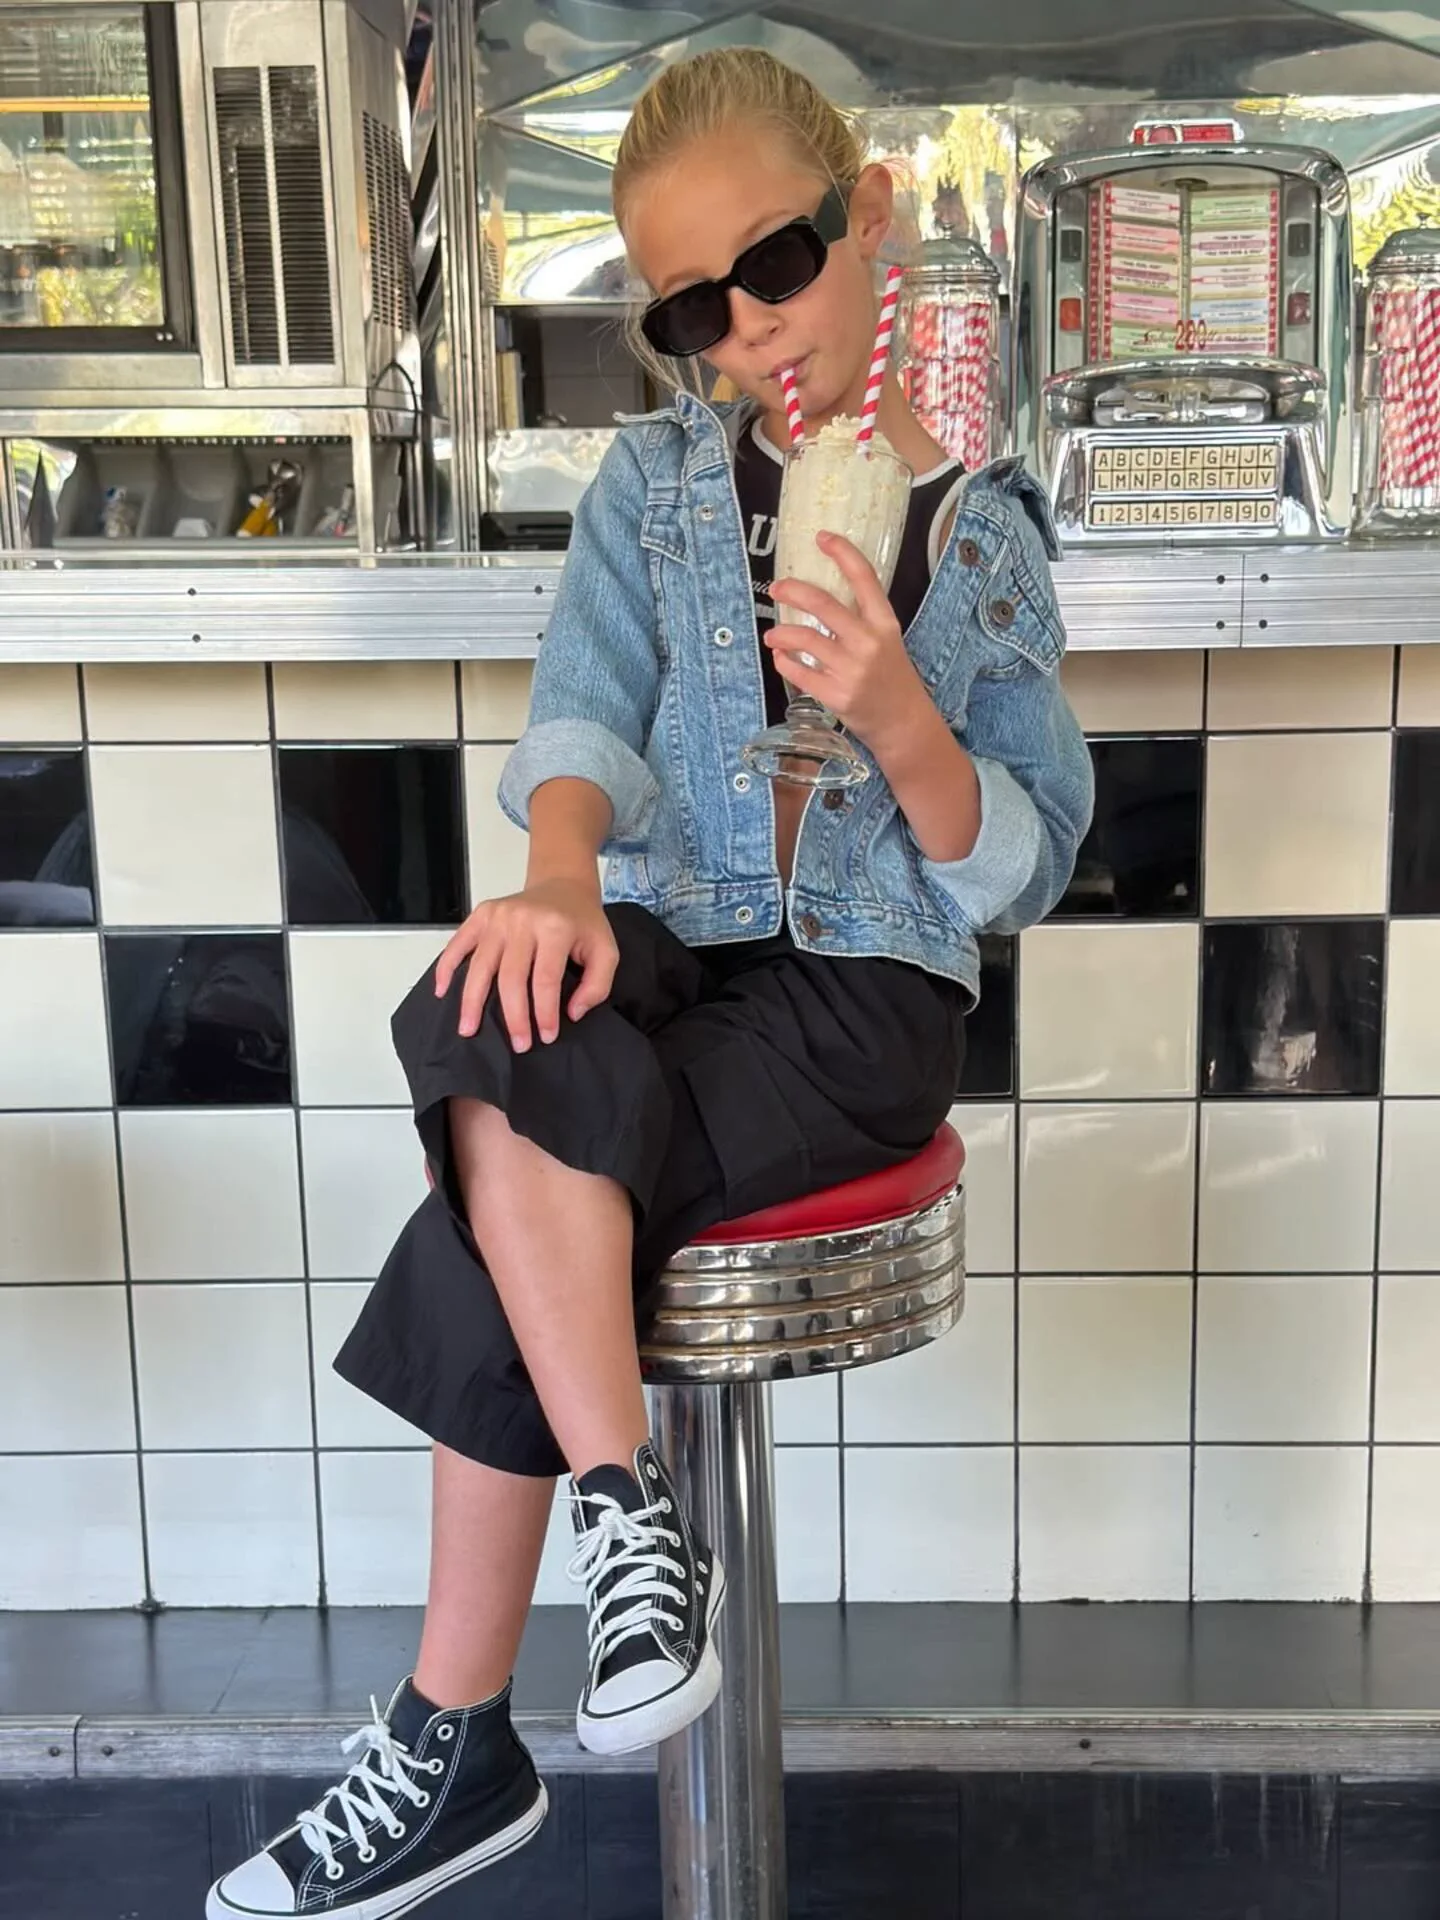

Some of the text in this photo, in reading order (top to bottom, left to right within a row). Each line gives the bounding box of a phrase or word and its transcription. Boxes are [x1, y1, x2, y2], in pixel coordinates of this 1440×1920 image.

[1098, 449, 1273, 467] A B C D E F G H J K
[1098, 471, 1272, 488] L M N P Q R S T U V
[1099, 505, 1270, 521] 1 2 3 4 5 6 7 8 9 0
